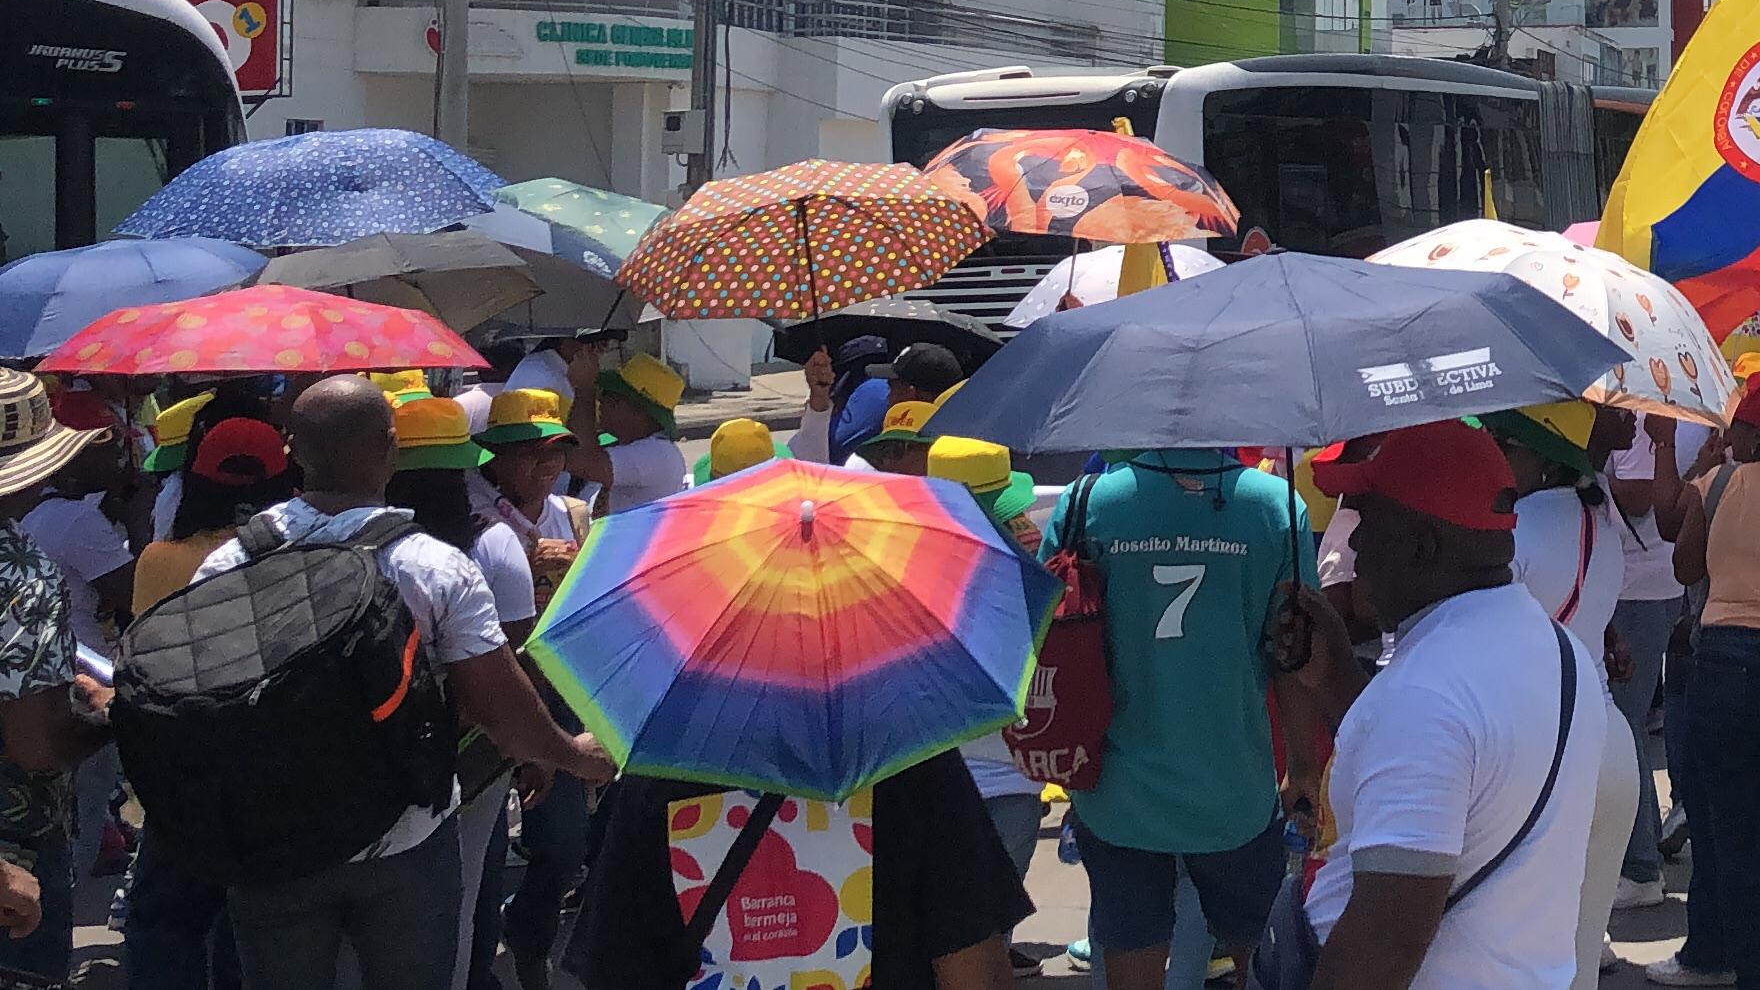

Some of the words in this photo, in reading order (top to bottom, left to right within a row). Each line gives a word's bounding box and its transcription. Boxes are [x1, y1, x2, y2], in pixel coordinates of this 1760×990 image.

[1152, 564, 1206, 639] 7
[1014, 744, 1090, 785] ARÇA
[743, 908, 797, 927] bermeja
